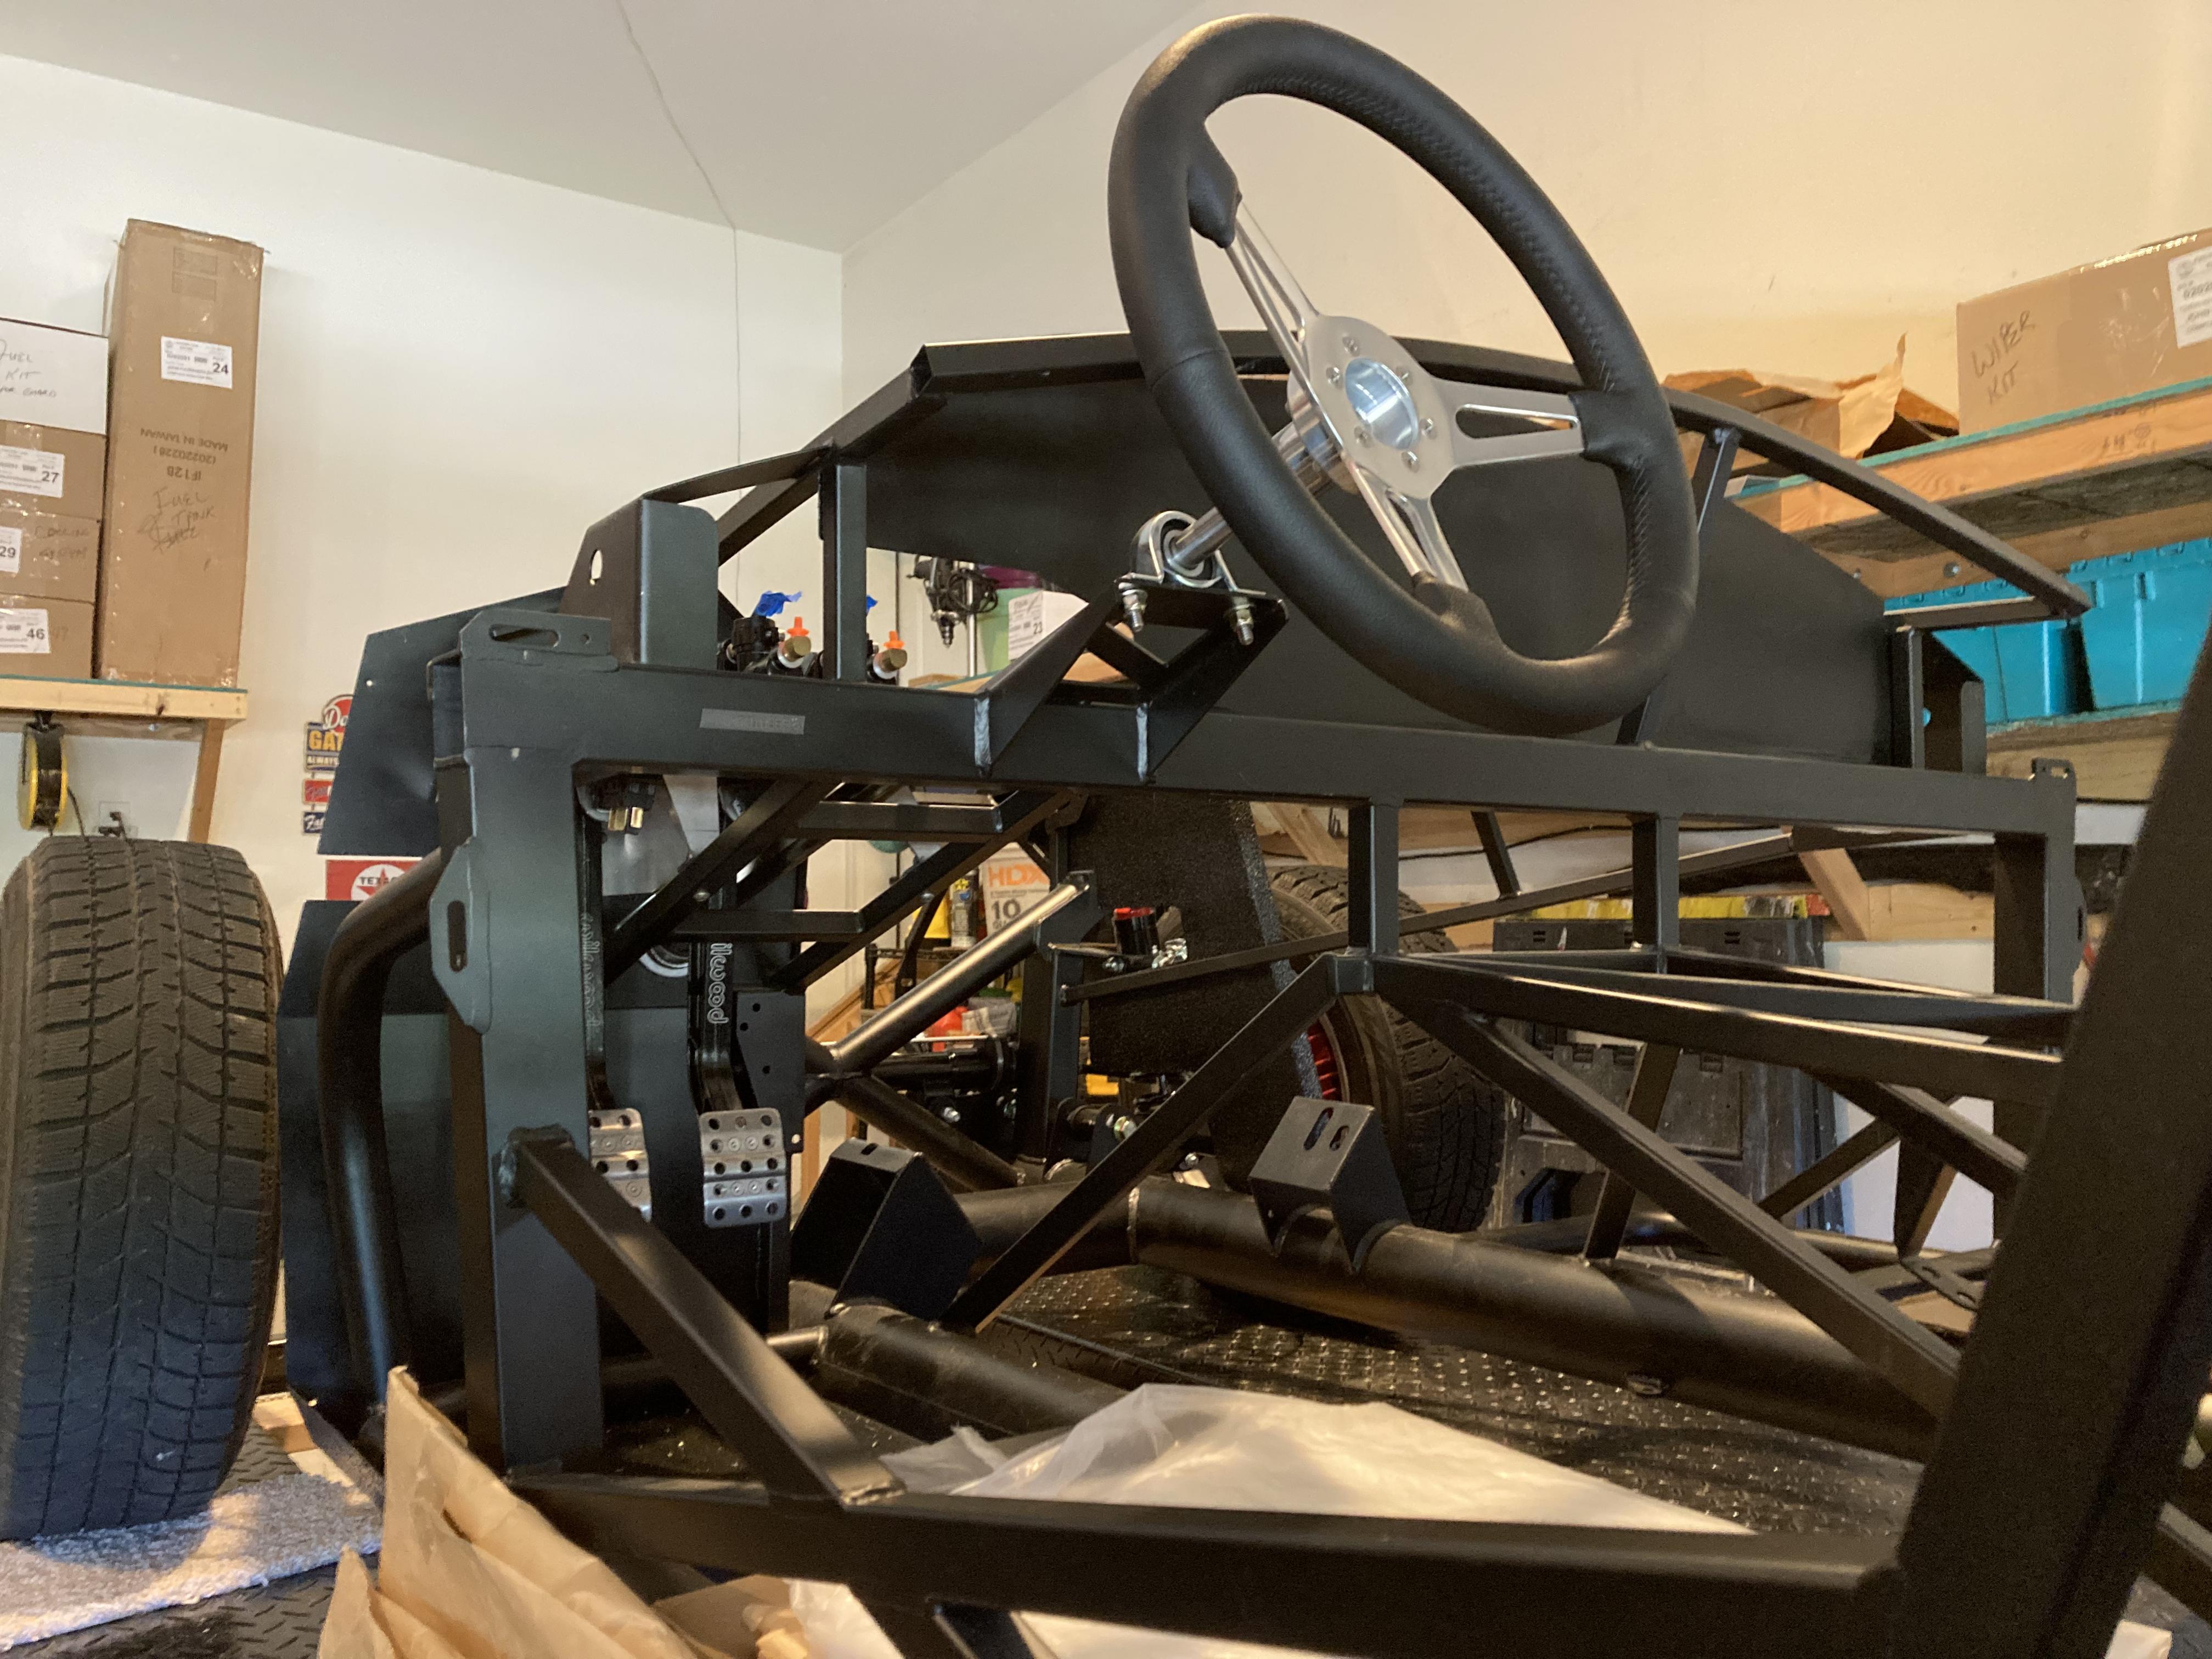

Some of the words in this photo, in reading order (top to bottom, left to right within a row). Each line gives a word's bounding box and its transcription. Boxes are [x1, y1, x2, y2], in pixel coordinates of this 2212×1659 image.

[212, 362, 229, 375] 24
[1988, 360, 2019, 405] KIT
[140, 428, 179, 443] TAIWAN
[184, 435, 195, 445] IN
[199, 438, 228, 452] MADE
[42, 471, 60, 483] 27
[0, 546, 16, 558] 29
[26, 628, 46, 640] 46
[1033, 622, 1043, 634] 23
[988, 863, 1050, 887] HDX
[991, 899, 1021, 920] 10
[706, 942, 734, 1024] ilwood
